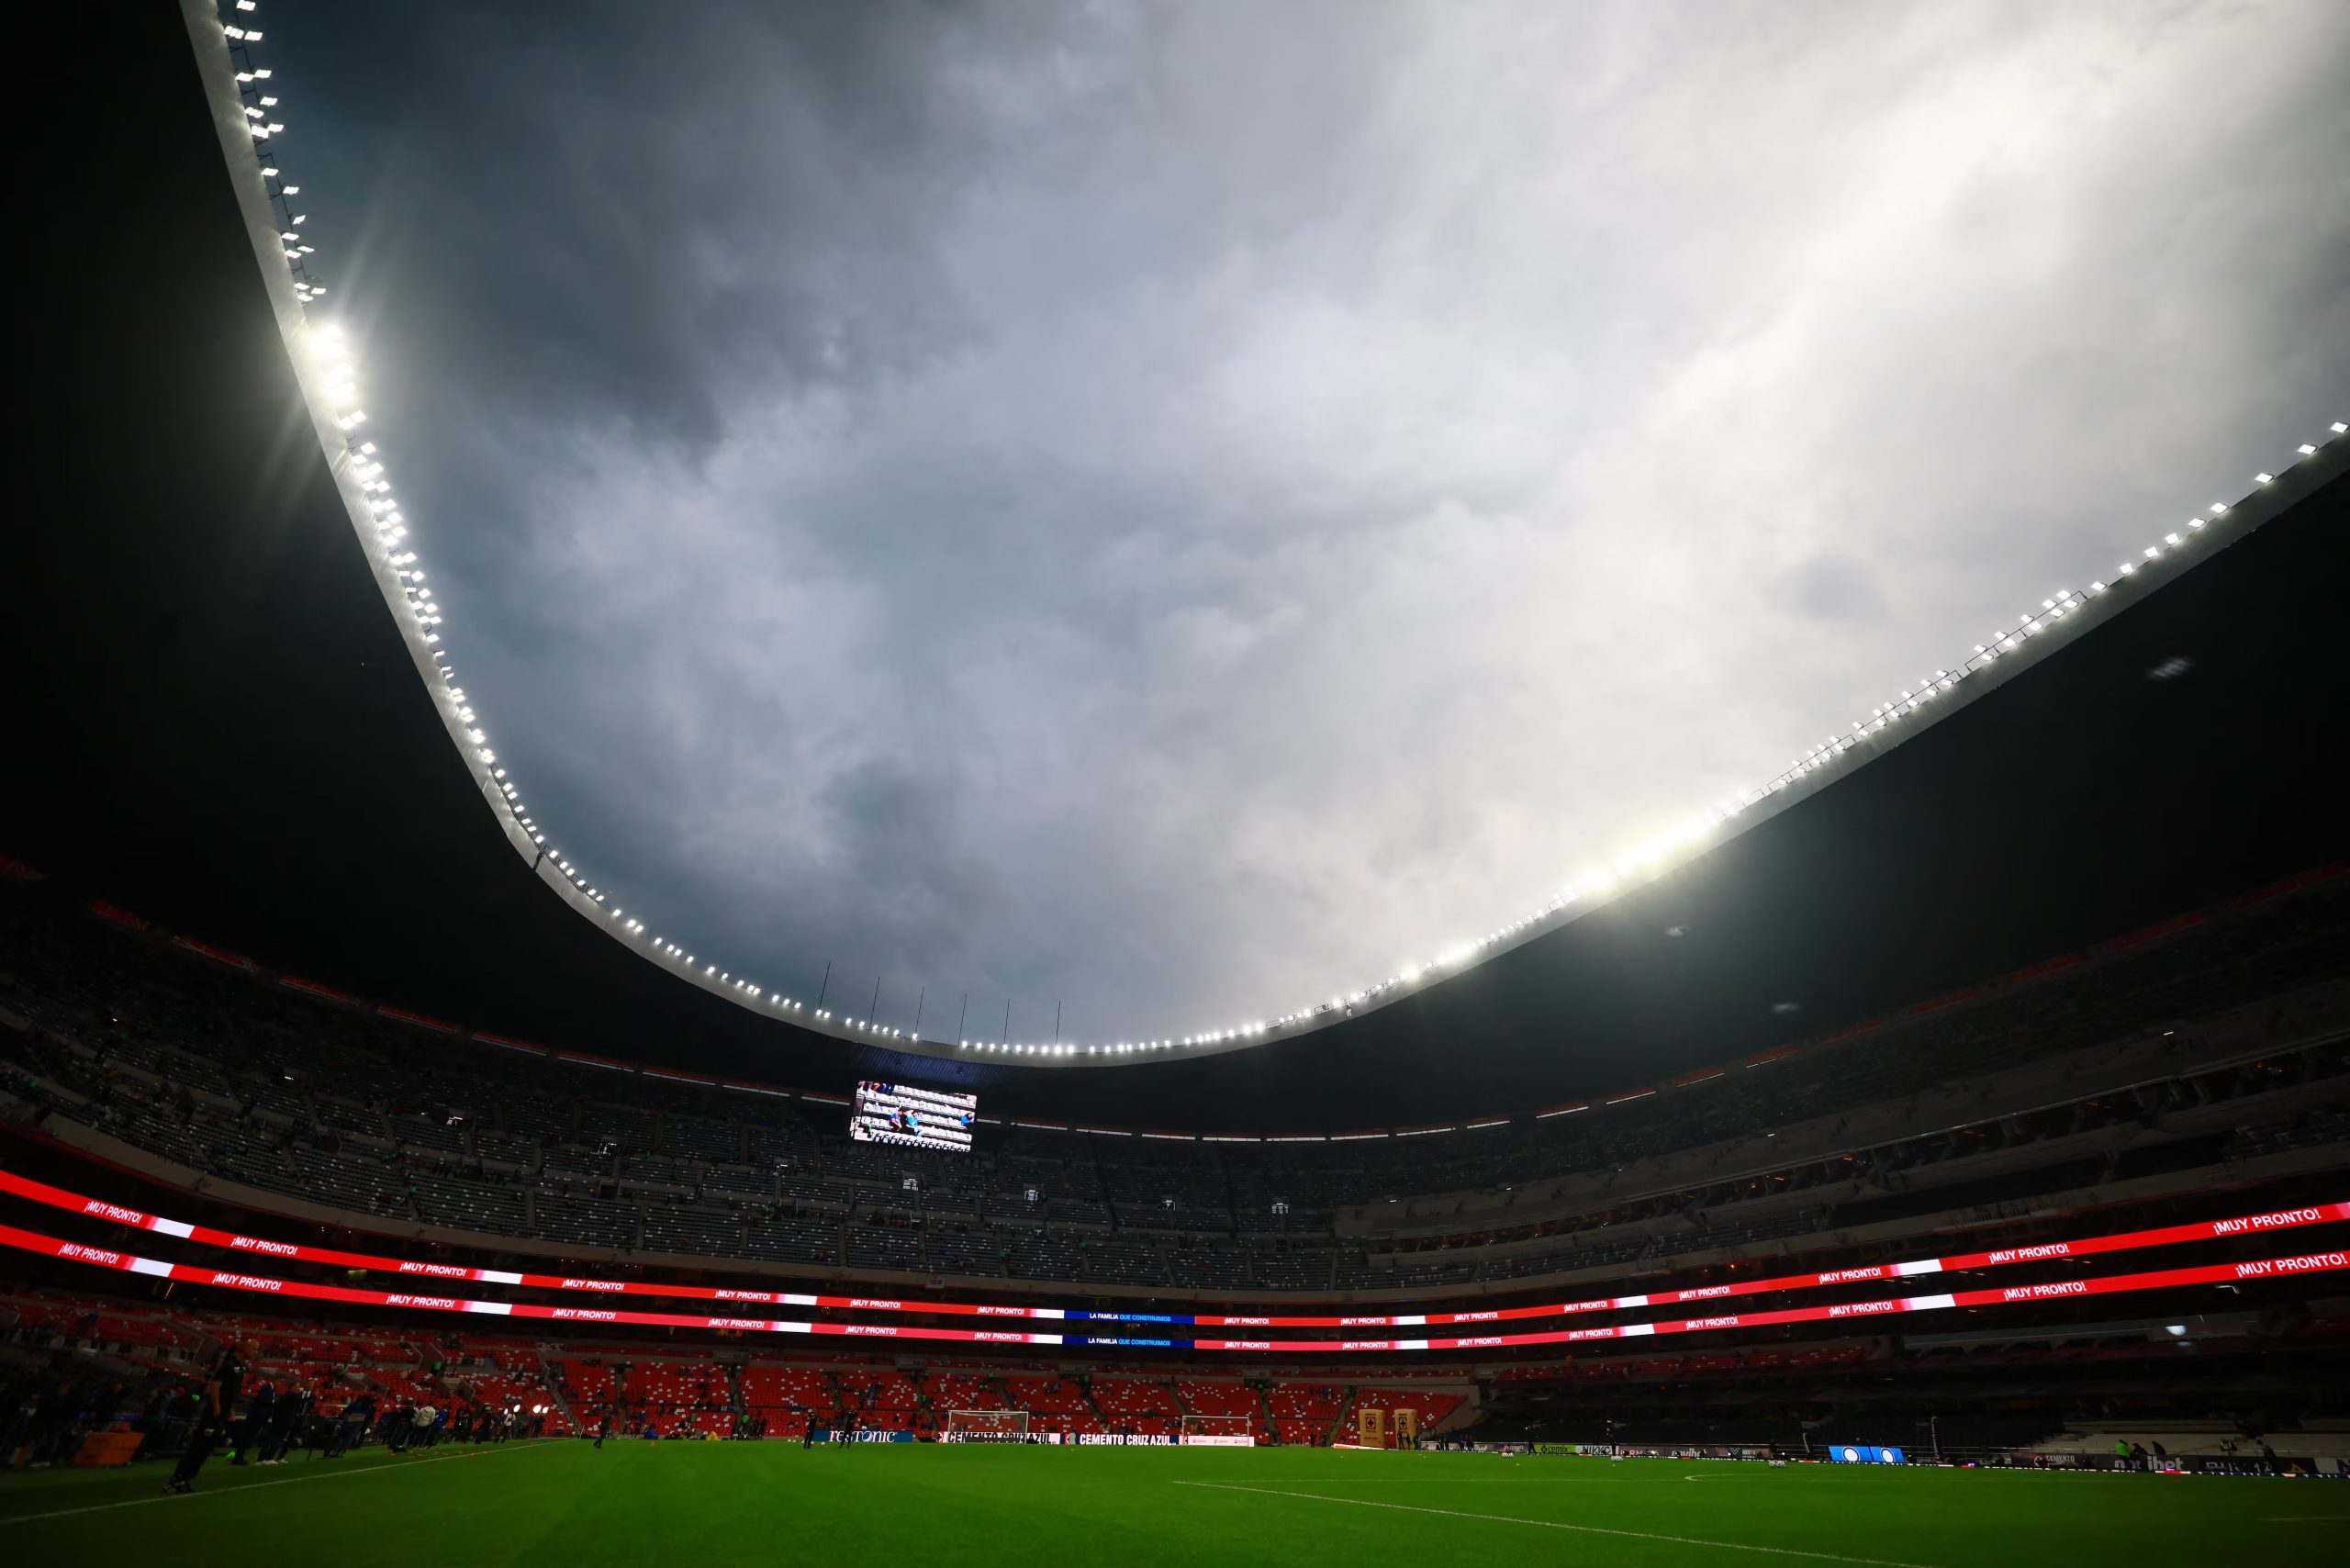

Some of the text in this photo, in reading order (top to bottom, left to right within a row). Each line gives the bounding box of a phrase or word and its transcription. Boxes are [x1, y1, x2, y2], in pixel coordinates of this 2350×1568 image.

[84, 1202, 142, 1223] ¡MUY PRONTO!
[2213, 1209, 2321, 1235] ¡MUY PRONTO!
[231, 1237, 297, 1255] ¡MUY PRONTO!
[59, 1244, 119, 1264] ¡MUY PRONTO!
[1989, 1244, 2069, 1264] ¡MUY PRONTO!
[399, 1262, 466, 1276] ¡MUY PRONTO!
[2235, 1254, 2347, 1277] ¡MUY PRONTO!
[213, 1273, 281, 1290] ¡MUY PRONTO!
[1818, 1268, 1882, 1283] ¡MUY PRONTO!
[587, 1282, 624, 1290] PRONTO!
[2004, 1282, 2087, 1301] ¡MUY PRONTO!
[737, 1292, 771, 1300] PRONTO!
[1679, 1286, 1730, 1301] ¡MUY PRONTO!
[386, 1295, 454, 1307] ¡MUY PRONTO!
[1564, 1301, 1607, 1313] ¡MUY PRONTO!
[553, 1309, 616, 1319] ¡MUY PRONTO!
[1829, 1302, 1893, 1317] ¡MUY PRONTO!
[708, 1318, 765, 1328] ¡MUY PRONTO!
[1454, 1314, 1470, 1322] ¡MUY
[1686, 1316, 1739, 1330] ¡MUY PRONTO!
[845, 1326, 897, 1335] ¡MUY PRONTO!
[992, 1333, 1022, 1341] PRONTO!
[1569, 1328, 1613, 1340] ¡MUY PRONTO!
[1457, 1338, 1472, 1347] ¡MUY
[1080, 1434, 1124, 1445] CEMENTO
[1126, 1434, 1151, 1445] CRUZ
[1549, 1445, 1568, 1453] cemix
